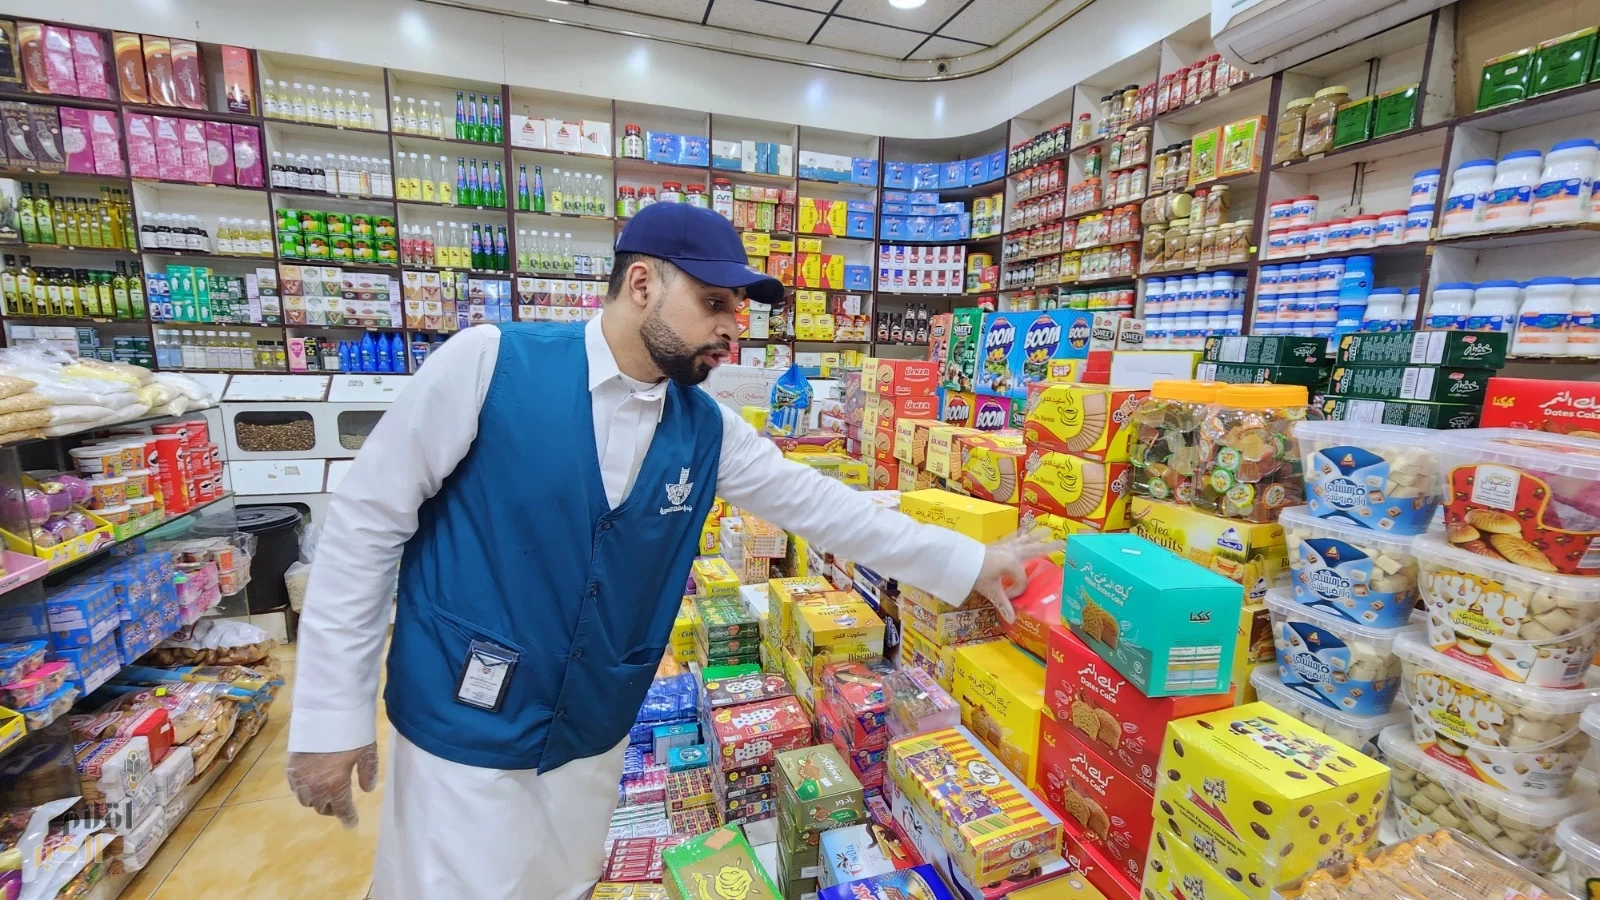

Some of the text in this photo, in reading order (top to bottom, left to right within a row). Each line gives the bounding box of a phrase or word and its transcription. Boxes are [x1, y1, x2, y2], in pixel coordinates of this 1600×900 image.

[986, 327, 1015, 349] BOOM
[1024, 325, 1061, 350] BOOM
[1069, 327, 1090, 339] BOOM
[1093, 328, 1114, 338] SWEET
[1121, 332, 1143, 342] SWEET
[904, 366, 930, 376] ÜLKER
[904, 399, 930, 409] ÜLKER
[945, 404, 970, 421] BOOM
[976, 410, 1006, 428] BOOM
[1543, 408, 1575, 418] Dates
[898, 425, 912, 437] ÜLKER
[931, 435, 948, 448] ÜLKER
[900, 464, 915, 477] ÜLKER
[1150, 518, 1170, 537] Tea
[1136, 525, 1184, 553] Biscuits
[1111, 593, 1125, 607] Cake
[848, 650, 880, 662] Biscuits
[1080, 676, 1117, 704] Dates Cake
[817, 752, 843, 782] Adore
[1071, 763, 1106, 796] Dates Cake
